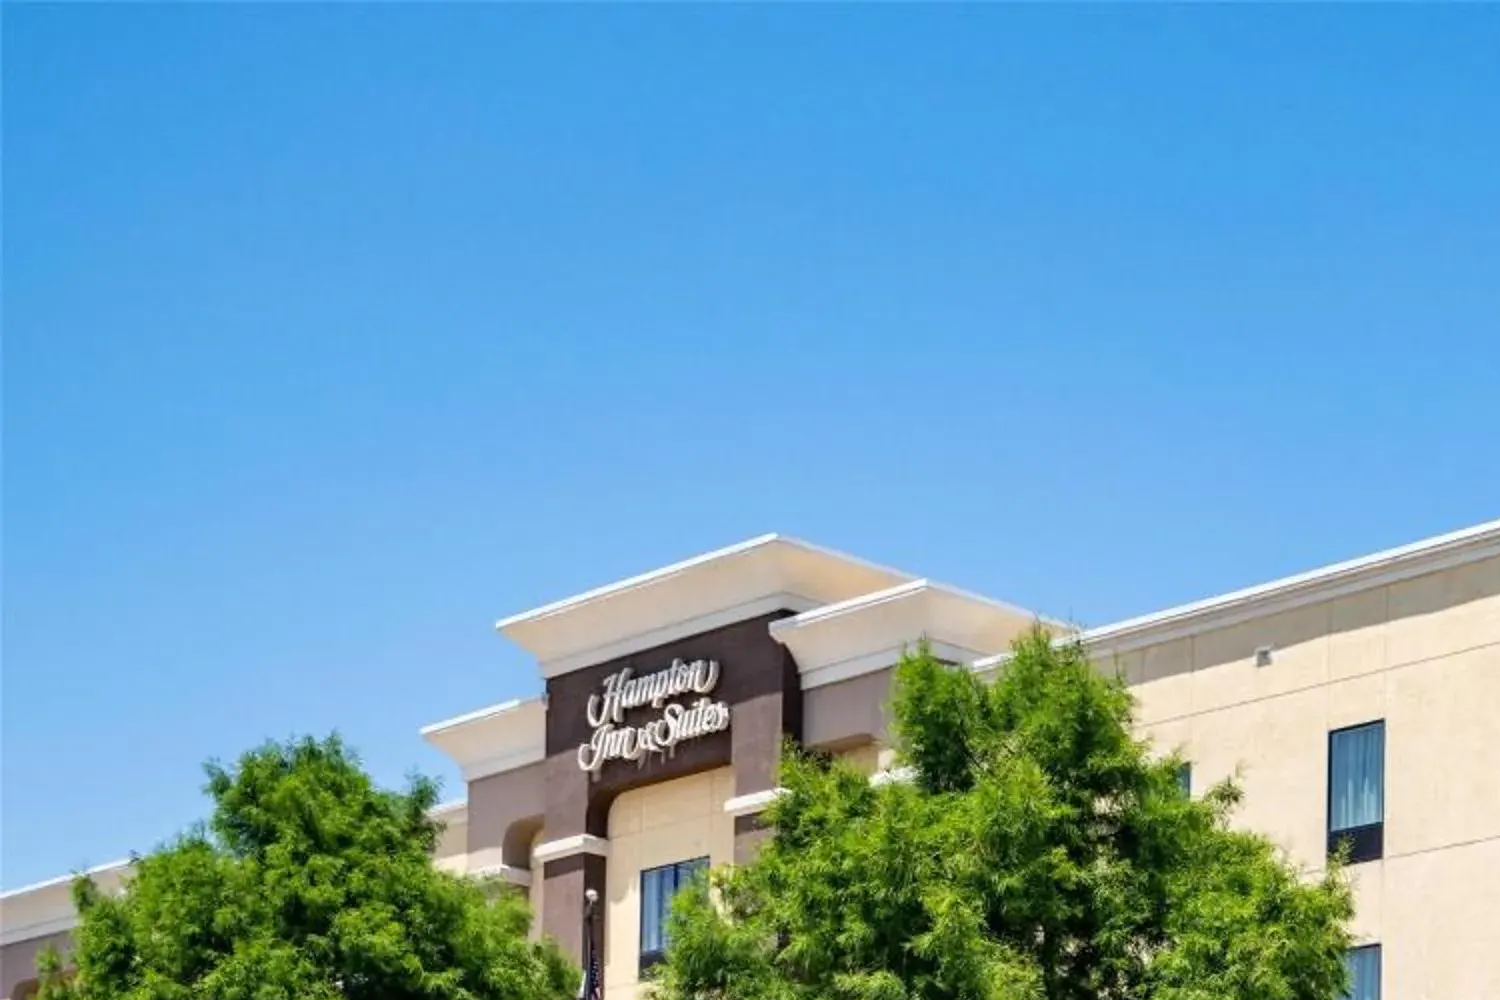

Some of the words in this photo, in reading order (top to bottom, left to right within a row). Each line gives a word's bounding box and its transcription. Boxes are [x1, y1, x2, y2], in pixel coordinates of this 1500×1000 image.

[587, 657, 720, 728] Hampton
[577, 723, 640, 772] Inn
[638, 721, 664, 753] &
[655, 697, 730, 747] Suites
